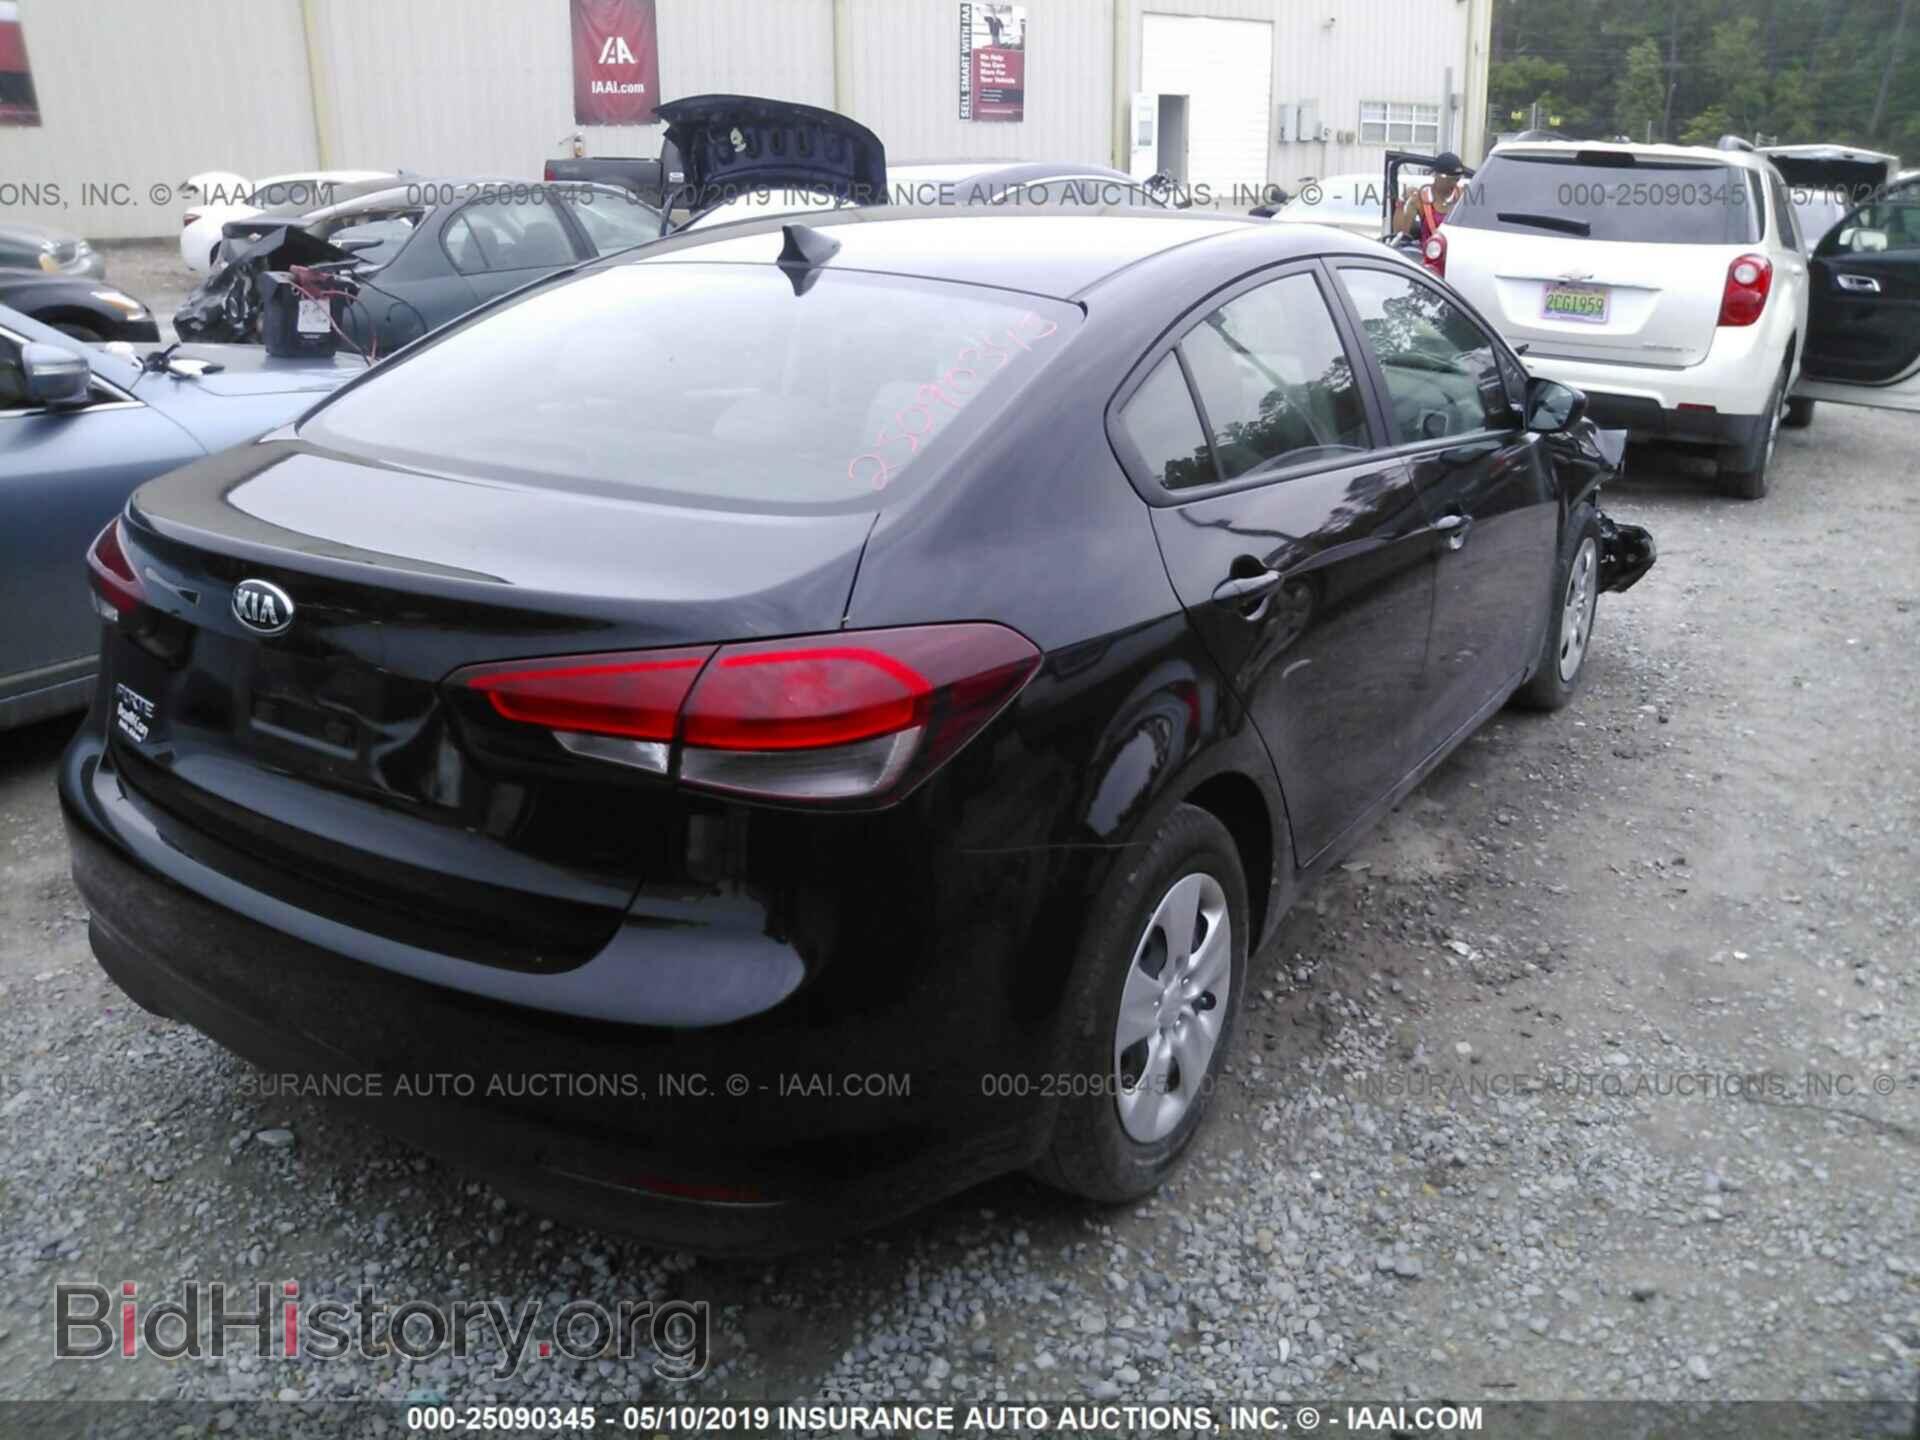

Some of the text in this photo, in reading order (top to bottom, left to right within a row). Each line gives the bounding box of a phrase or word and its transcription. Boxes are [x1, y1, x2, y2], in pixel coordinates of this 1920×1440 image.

[960, 27, 970, 54] WITH
[591, 80, 645, 94] IAAI.com
[960, 56, 970, 92] SMART
[960, 95, 970, 119] SELL
[236, 587, 280, 625] KIA
